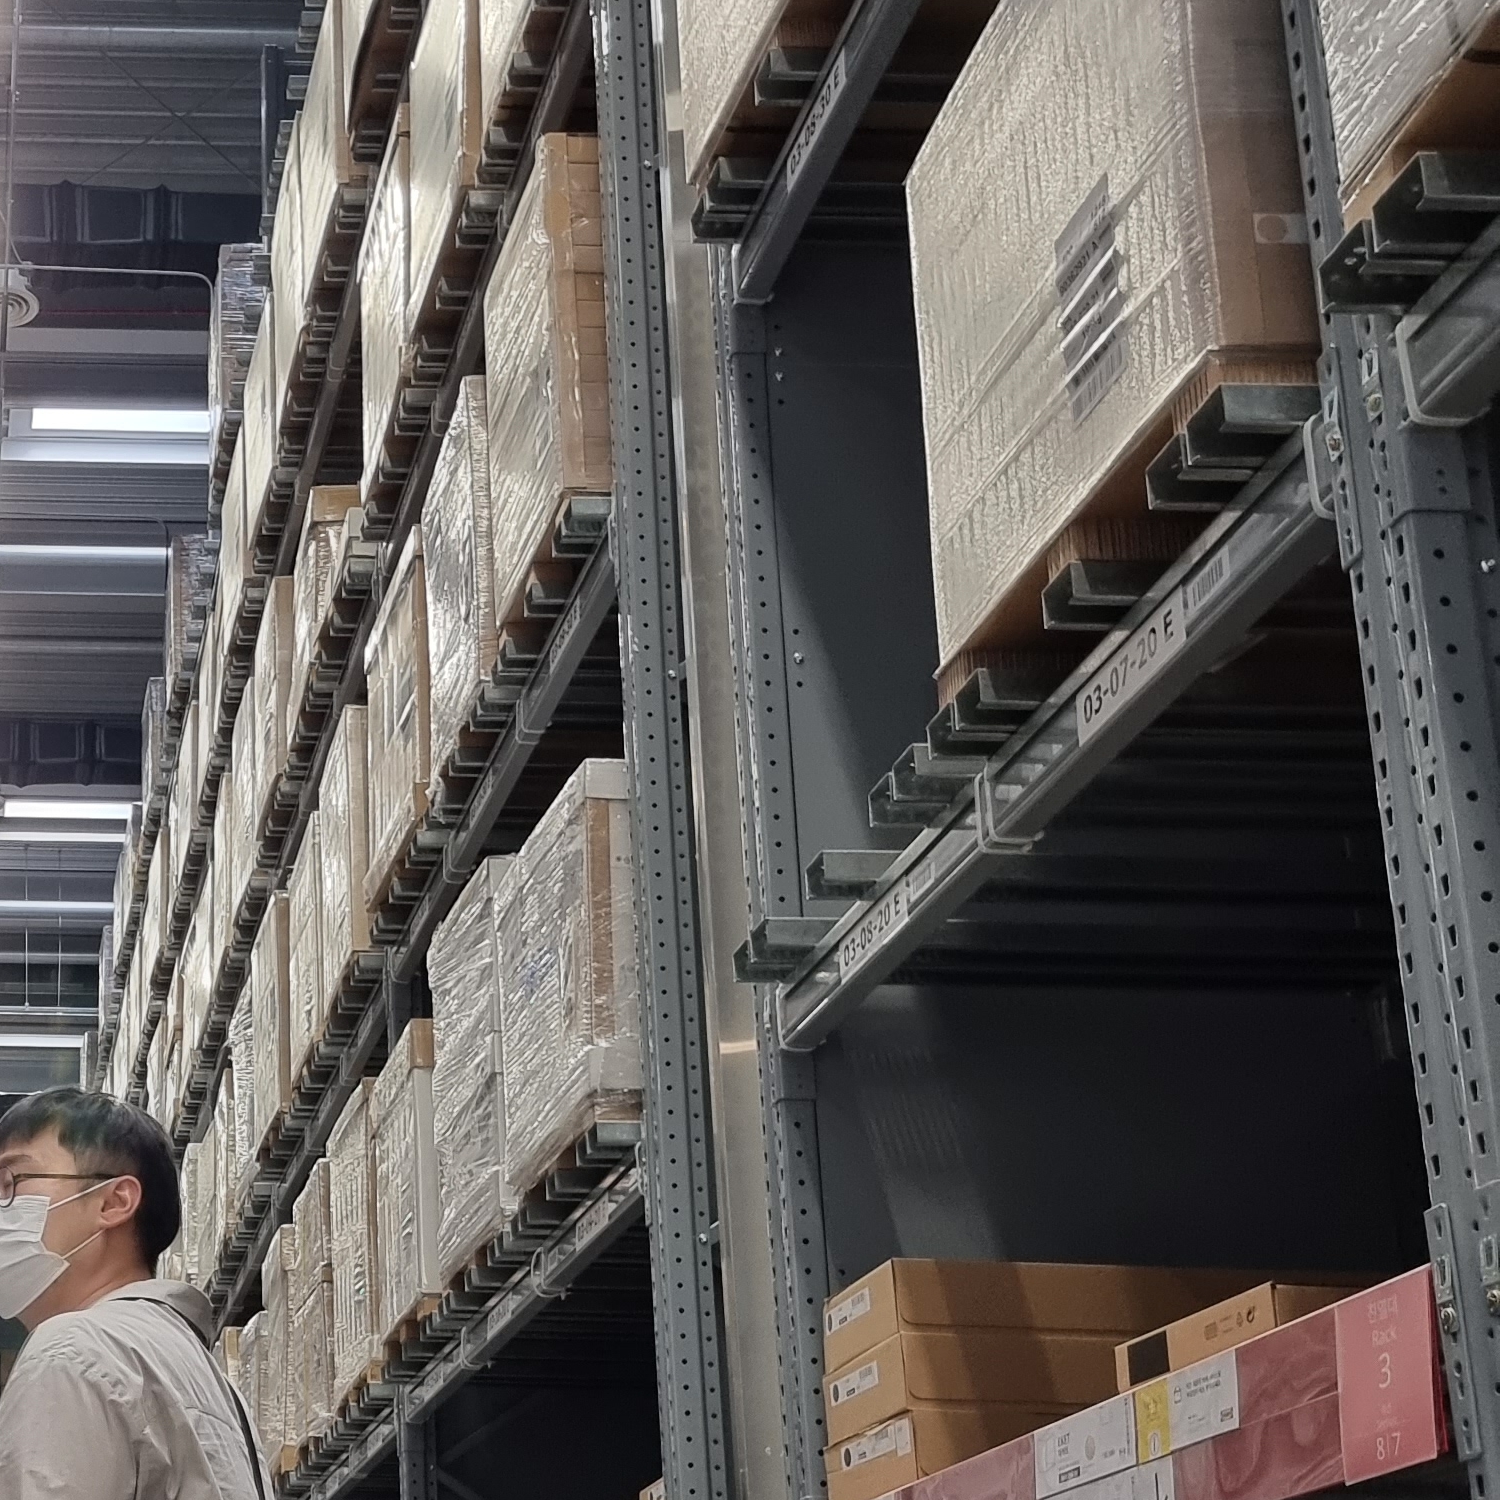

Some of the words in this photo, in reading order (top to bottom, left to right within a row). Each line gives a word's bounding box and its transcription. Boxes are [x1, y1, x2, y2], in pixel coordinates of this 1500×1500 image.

[833, 65, 839, 90] E
[1083, 627, 1157, 724] 03-07-20
[1163, 608, 1174, 643] E
[843, 902, 890, 967] 03-08-20
[893, 891, 900, 917] E
[1372, 1326, 1397, 1346] Rack
[1378, 1352, 1391, 1389] 3
